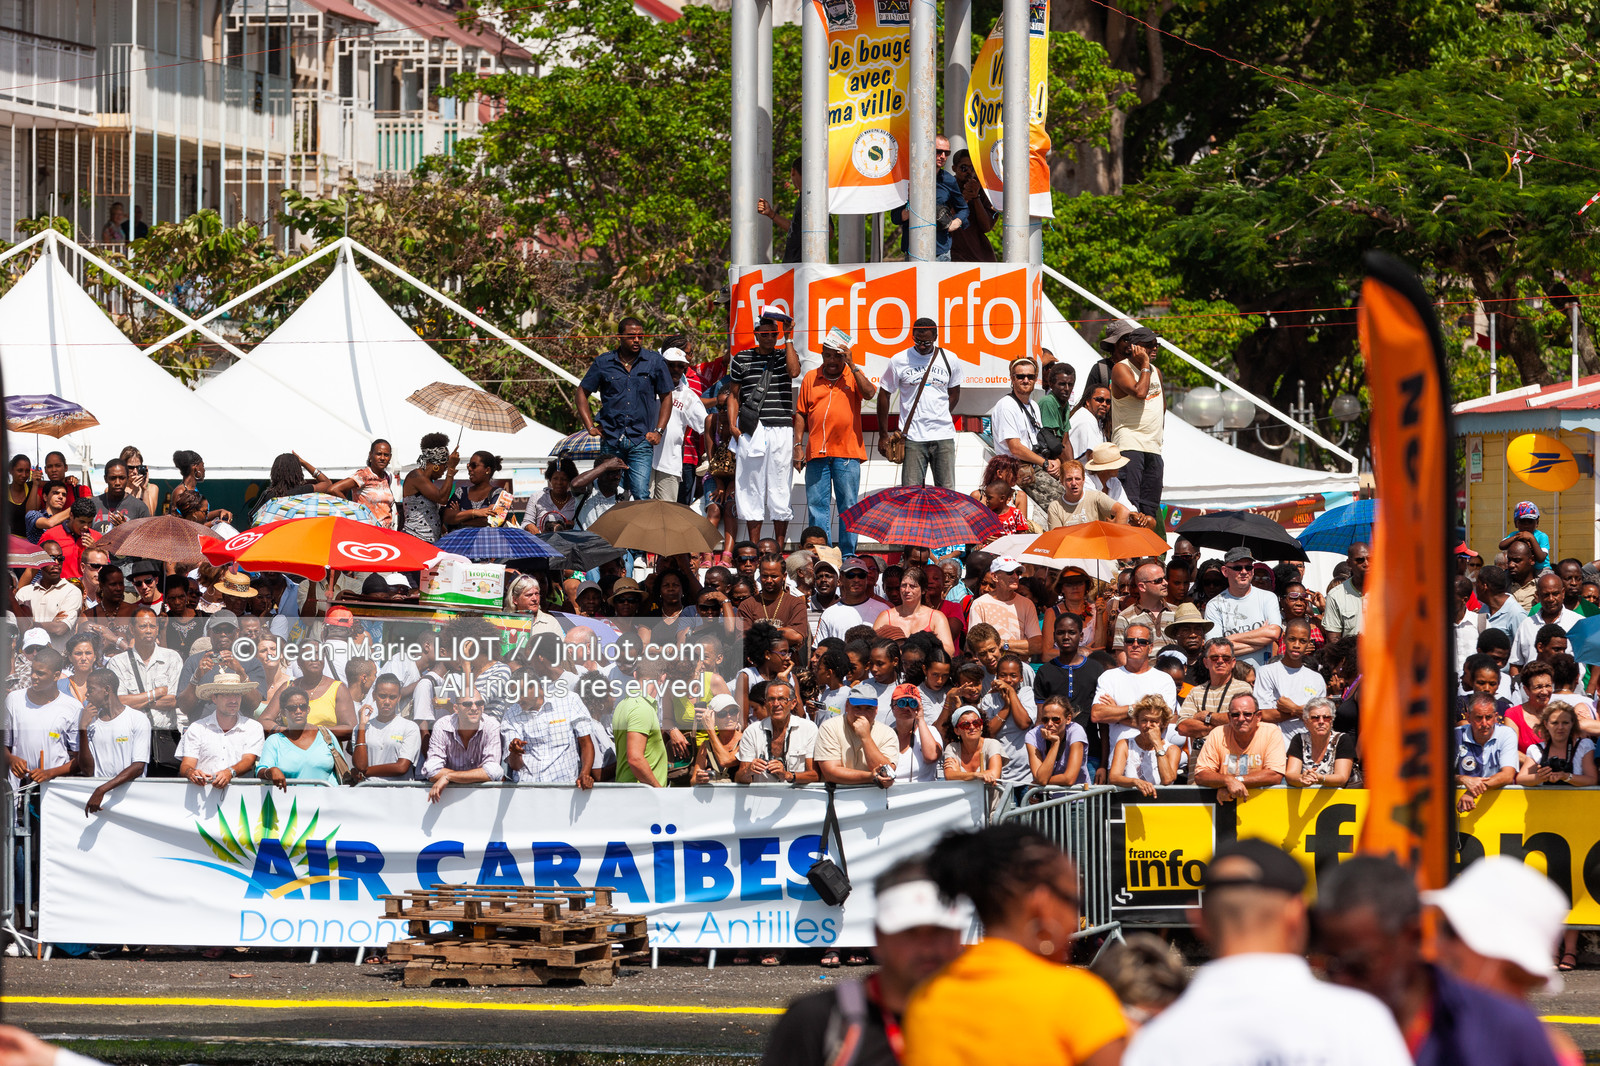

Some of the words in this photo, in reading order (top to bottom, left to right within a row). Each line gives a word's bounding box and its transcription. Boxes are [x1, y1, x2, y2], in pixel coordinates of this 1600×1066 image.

[829, 46, 850, 70] Je
[859, 39, 910, 63] bouge
[850, 68, 891, 93] avec
[828, 104, 852, 126] ma
[861, 88, 902, 117] ville
[817, 281, 910, 345] rfo
[944, 280, 1022, 346] rfo
[244, 837, 393, 901] AIR
[416, 823, 830, 904] CARAÏBES
[1128, 847, 1168, 859] france
[1129, 849, 1209, 888] info
[694, 911, 837, 945] Antilles
